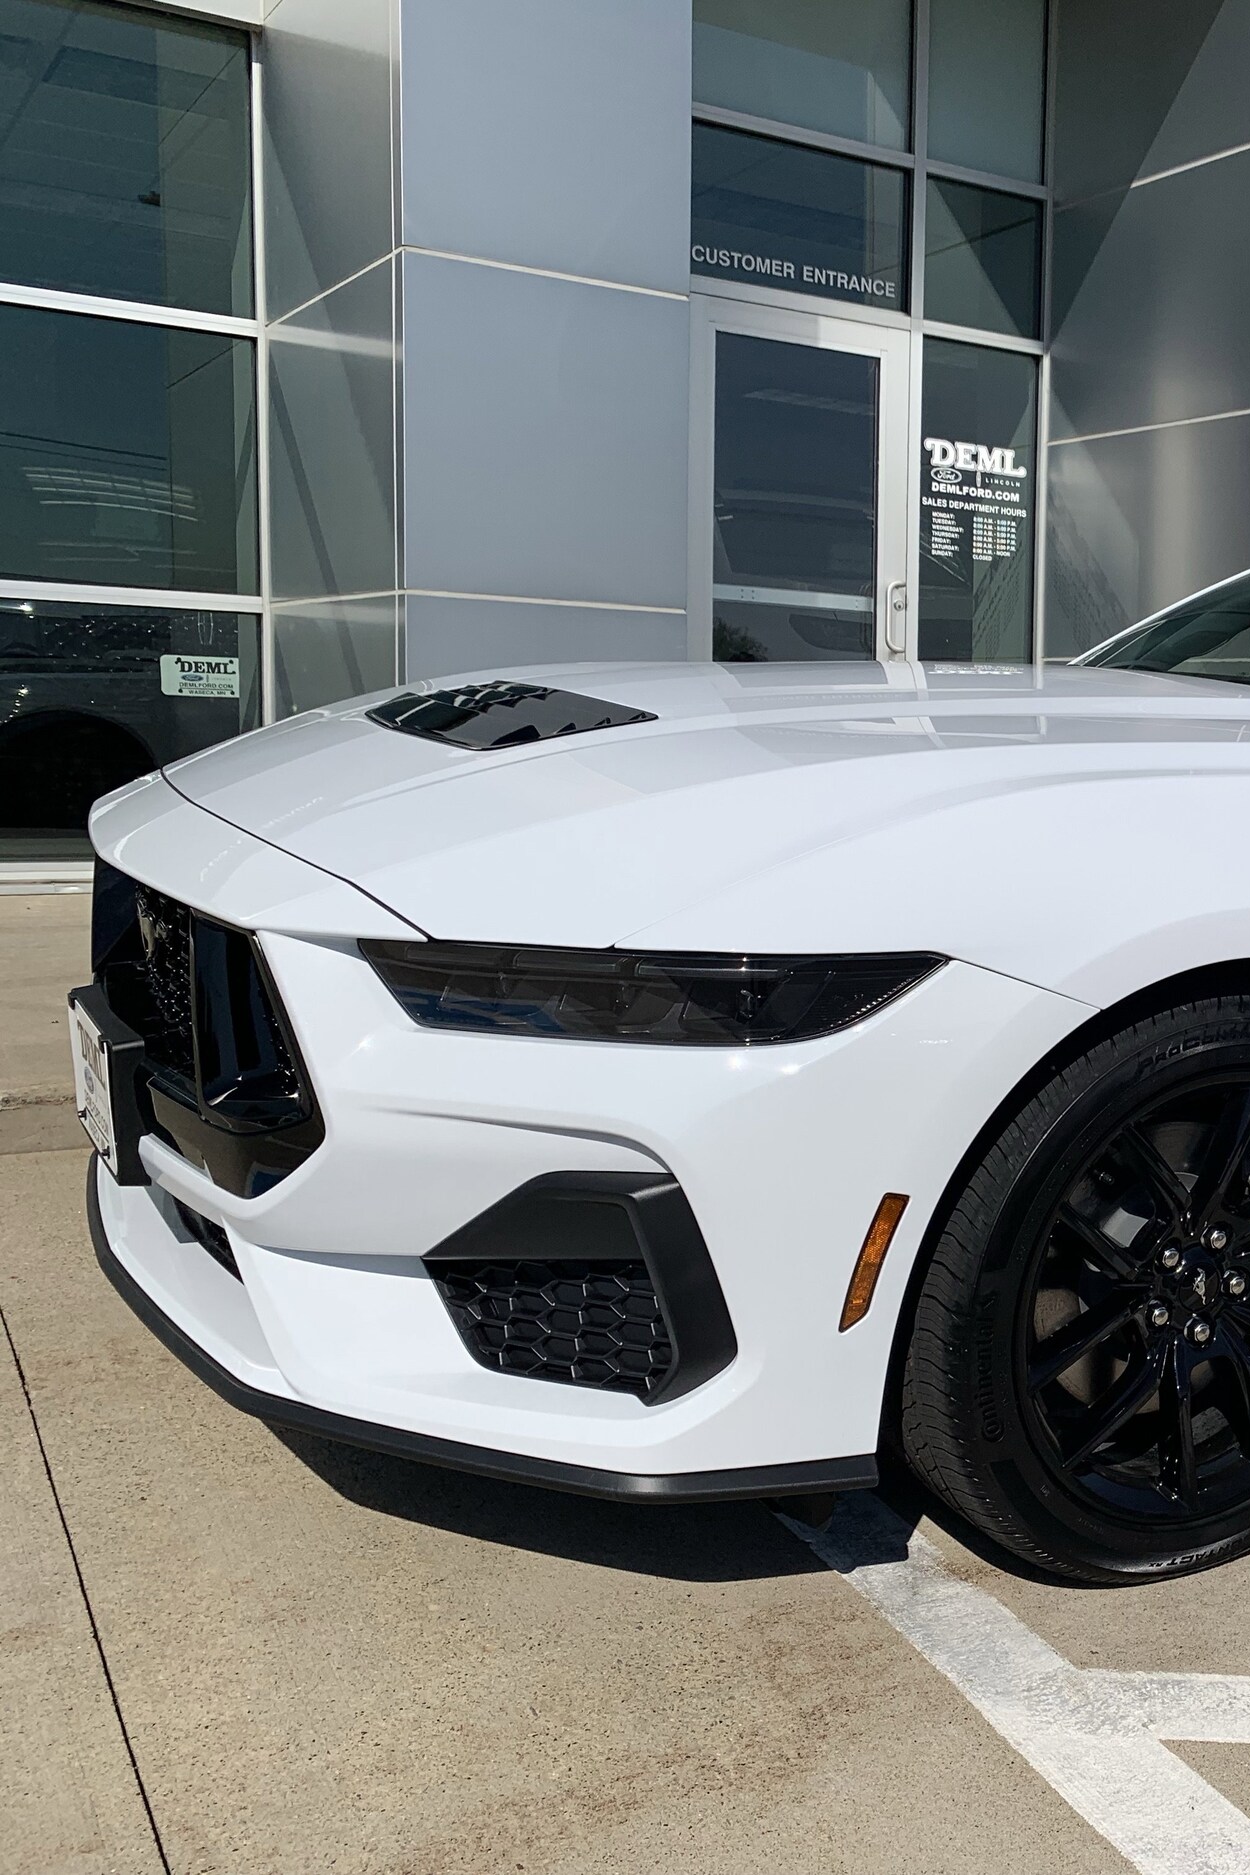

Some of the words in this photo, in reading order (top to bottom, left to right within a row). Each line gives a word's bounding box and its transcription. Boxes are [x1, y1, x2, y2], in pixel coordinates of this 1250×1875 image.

[691, 245, 796, 280] CUSTOMER
[802, 265, 897, 298] ENTRANCE
[923, 437, 1028, 479] DEML
[931, 481, 1020, 503] DEMLFORD.COM
[985, 477, 1021, 488] LINCOLN
[921, 496, 948, 509] SALES
[948, 500, 1000, 515] DEPARTMENT
[1000, 507, 1027, 518] HOURS
[175, 660, 237, 675] DEML
